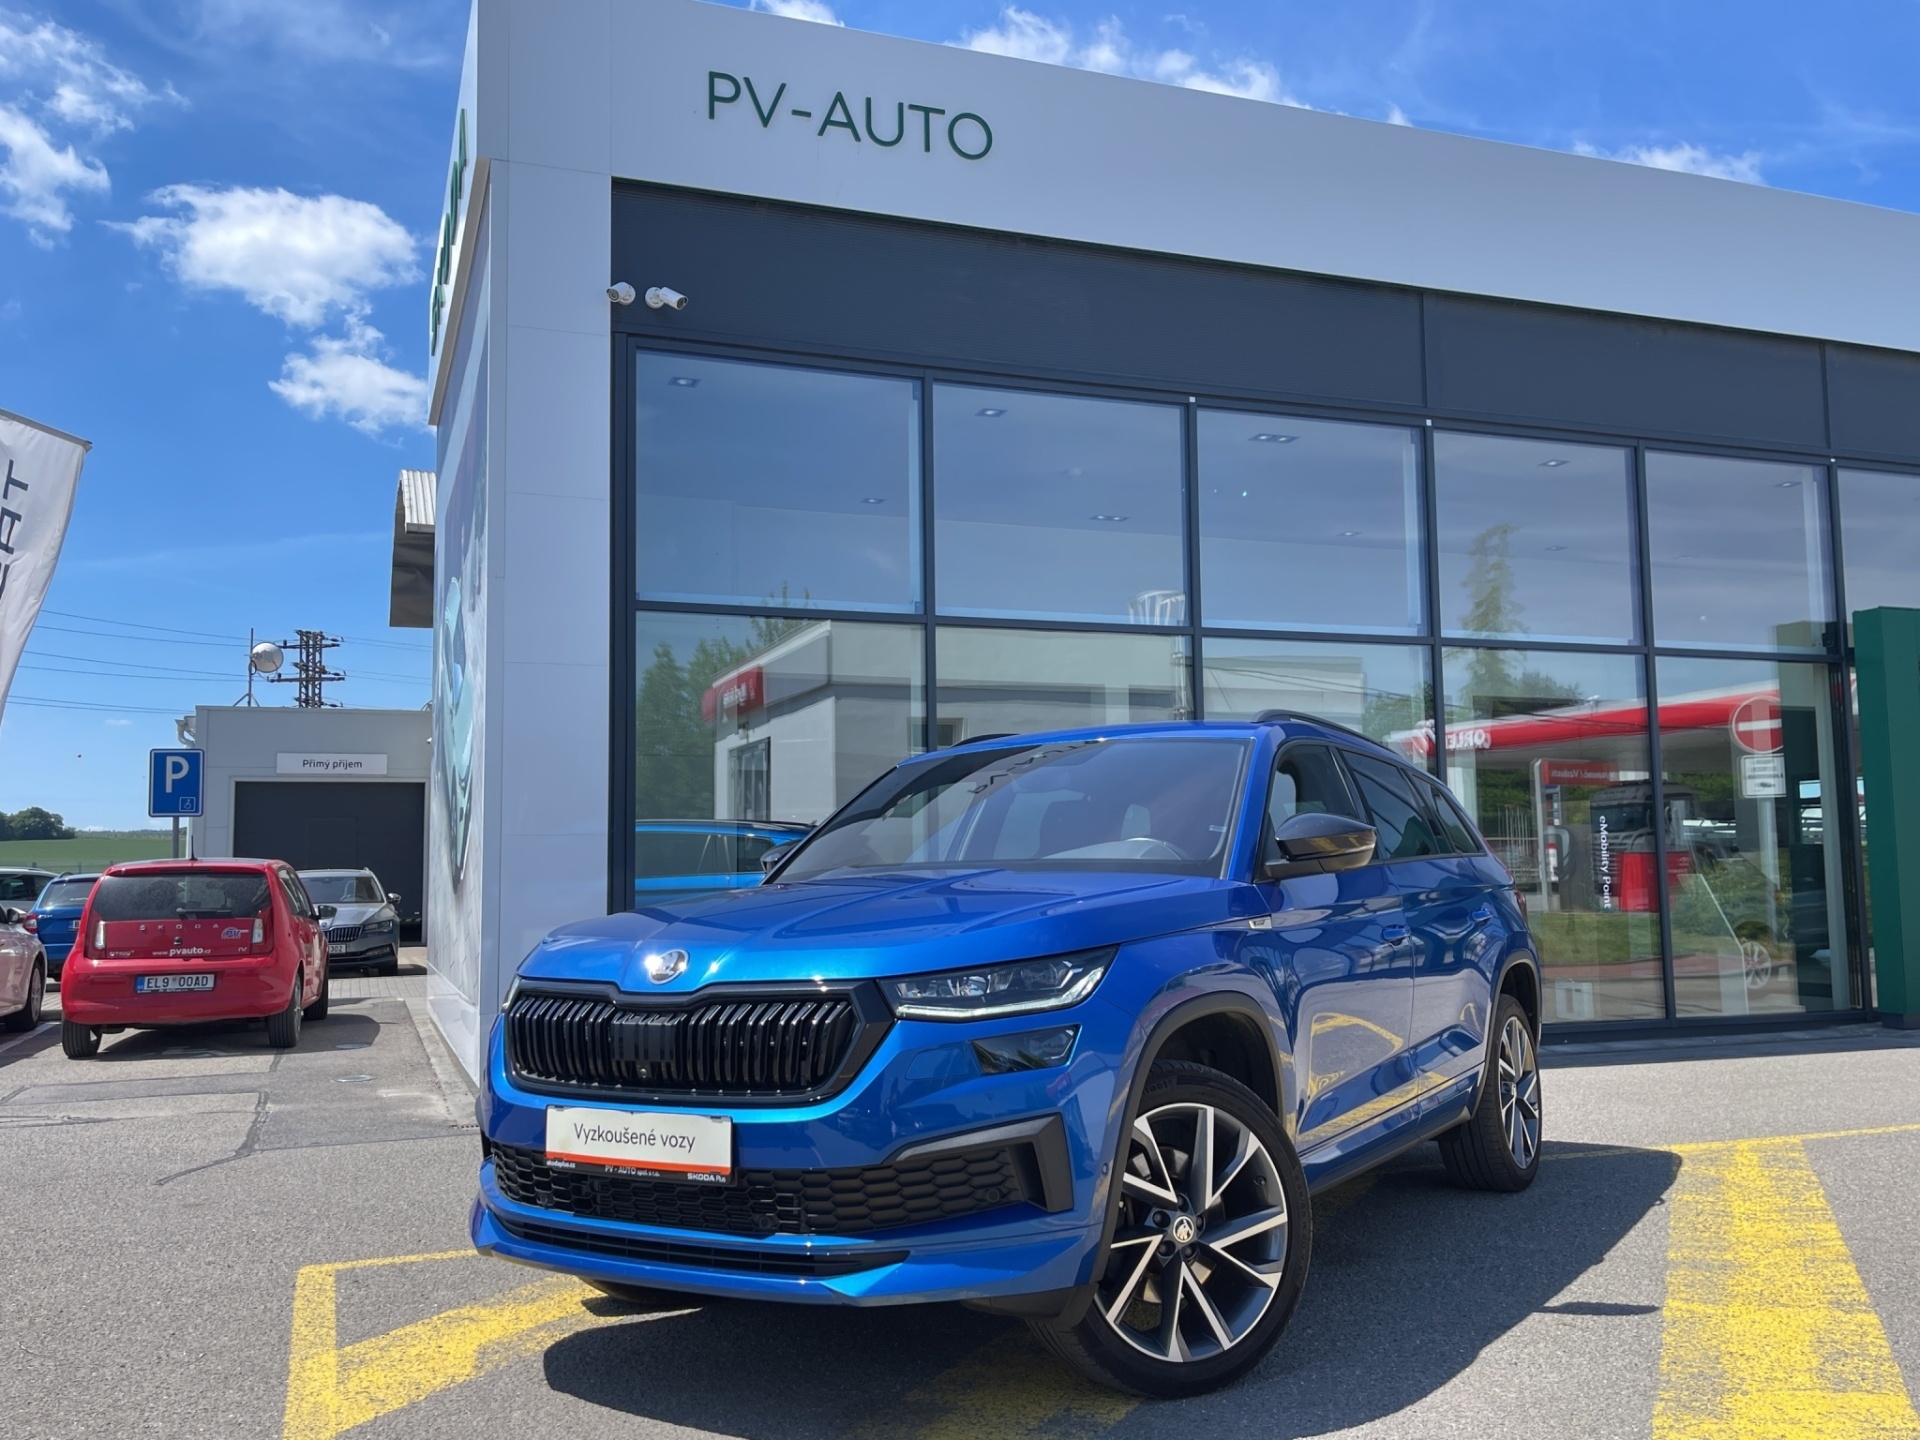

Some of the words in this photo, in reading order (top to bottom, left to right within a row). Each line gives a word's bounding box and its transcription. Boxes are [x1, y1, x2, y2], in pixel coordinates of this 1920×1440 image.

[708, 70, 993, 160] PV-AUTO
[165, 755, 190, 793] P
[302, 759, 330, 770] Přímý
[332, 759, 363, 770] příjem
[1599, 815, 1610, 873] eMobility
[1602, 876, 1612, 909] Point
[574, 1122, 656, 1146] Vyzkoušené
[660, 1134, 696, 1153] vozy
[618, 1166, 636, 1175] AUTO
